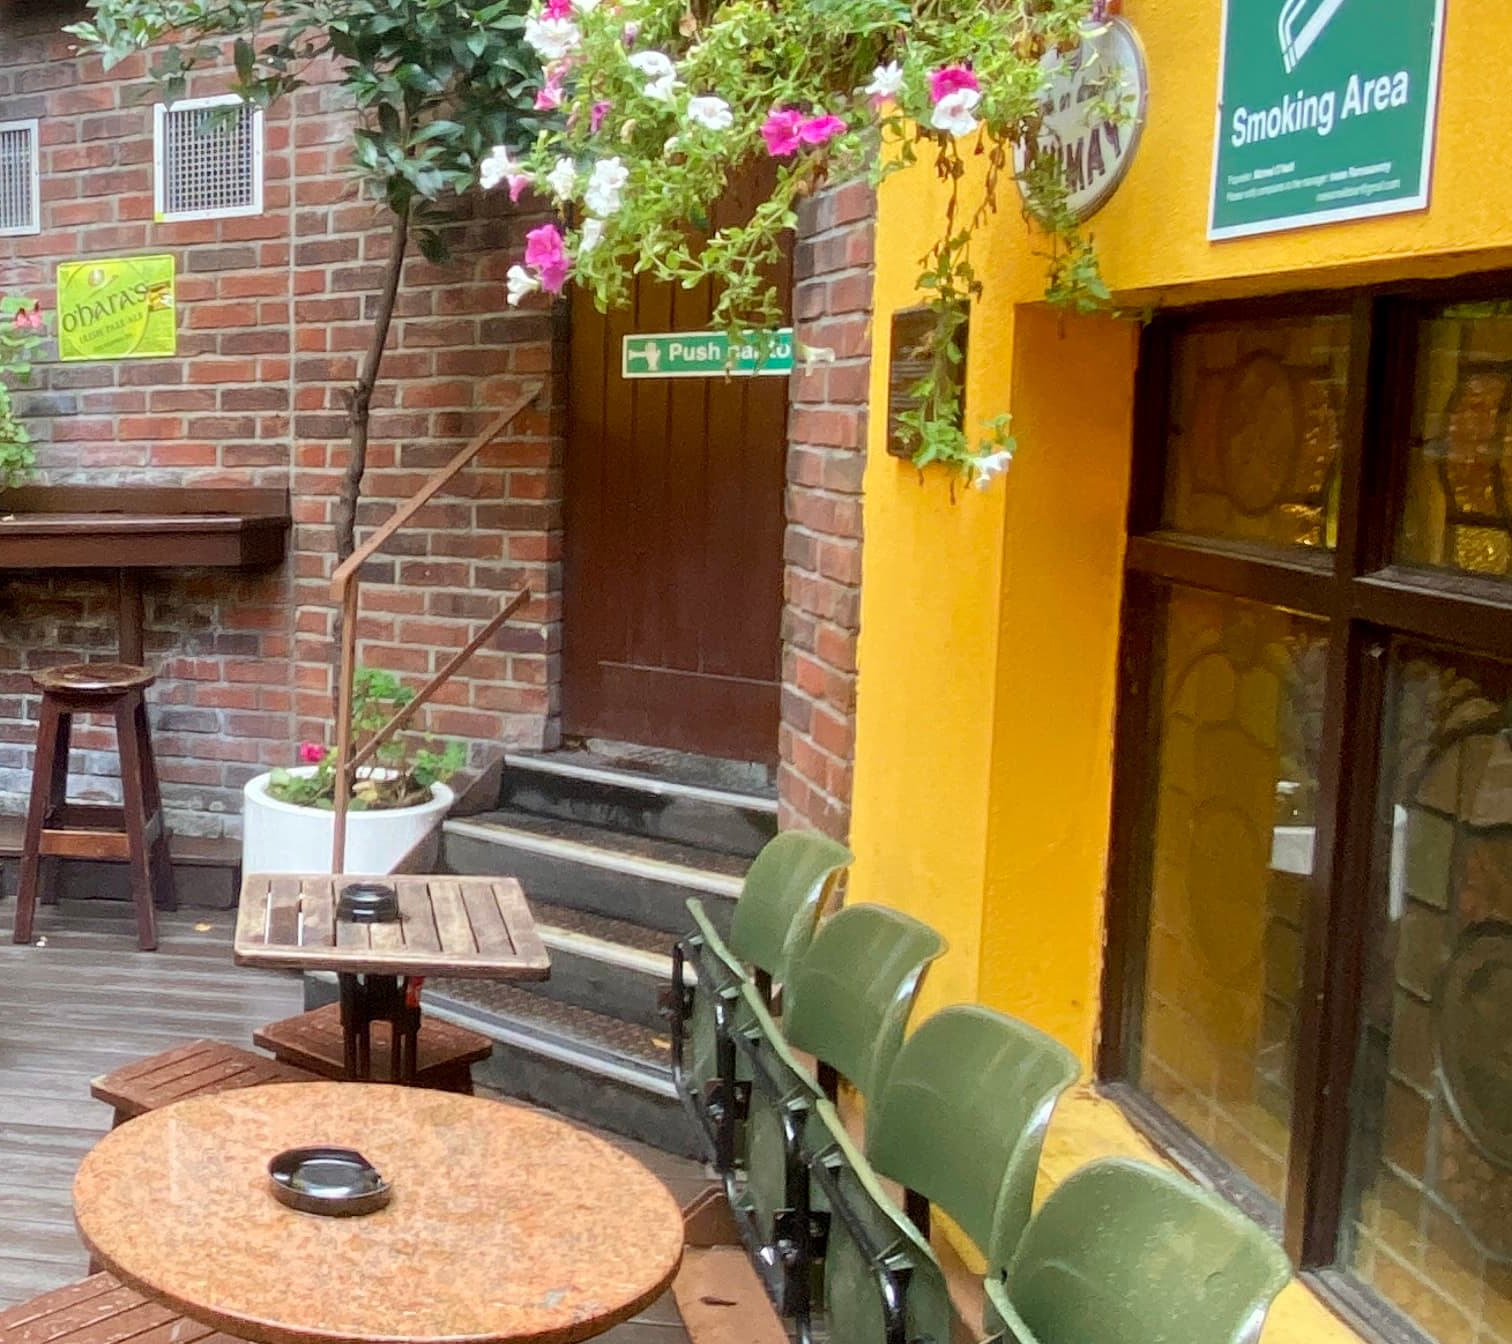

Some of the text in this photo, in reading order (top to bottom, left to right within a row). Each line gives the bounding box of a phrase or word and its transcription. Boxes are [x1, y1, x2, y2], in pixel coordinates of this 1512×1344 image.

[1231, 70, 1409, 148] Smoking Area
[668, 342, 721, 362] Push
